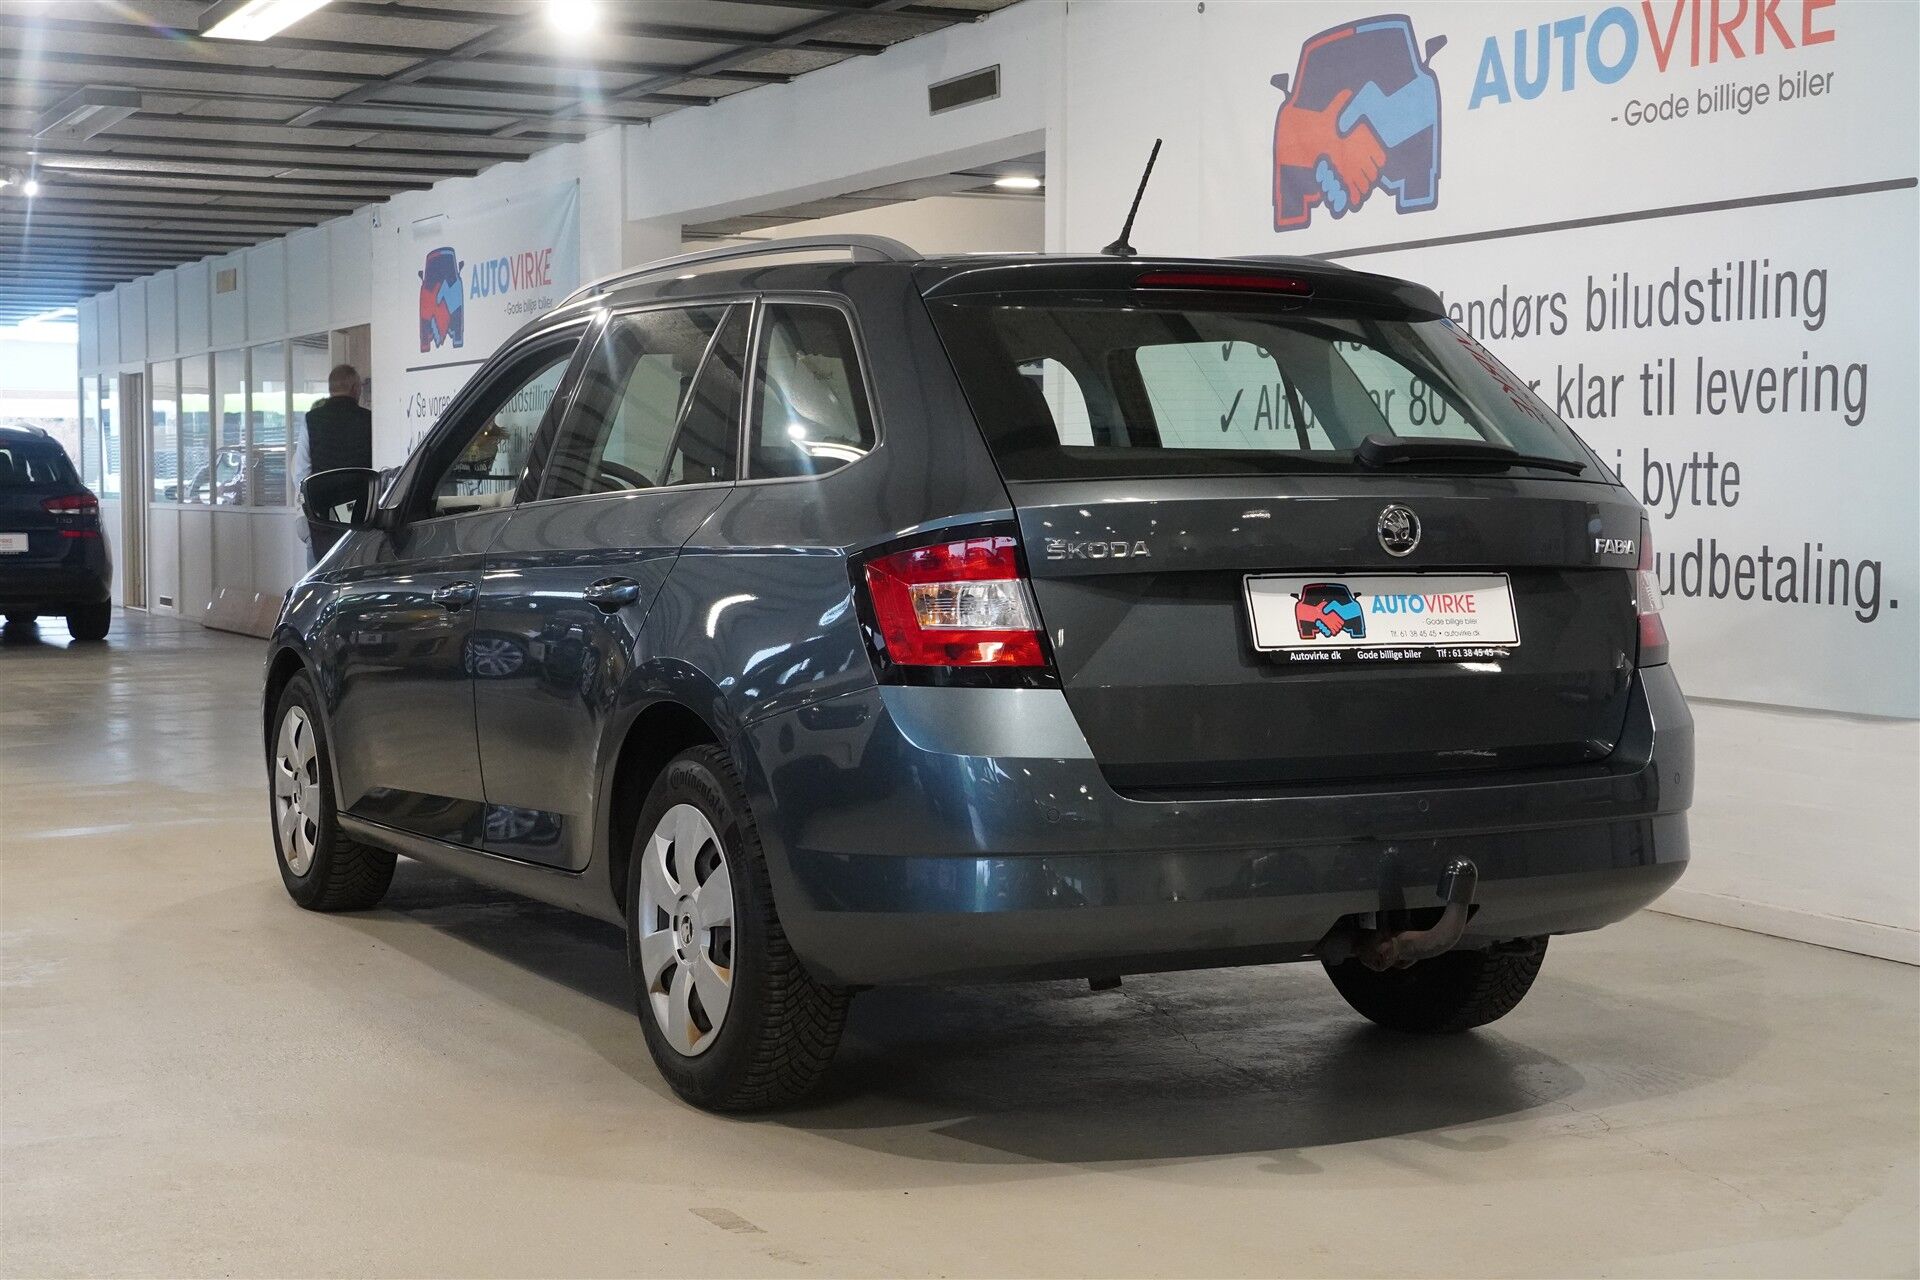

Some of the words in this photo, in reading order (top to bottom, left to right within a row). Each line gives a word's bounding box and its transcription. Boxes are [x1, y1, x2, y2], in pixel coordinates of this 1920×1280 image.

[1624, 96, 1689, 126] Gode
[1698, 83, 1770, 115] billige
[1779, 69, 1834, 102] biler
[470, 249, 553, 299] AUTOVIRKE
[1440, 284, 1568, 341] endørs
[1586, 258, 1828, 332] biludstilling
[416, 392, 426, 418] Se
[1556, 365, 1625, 420] klar
[1639, 358, 1676, 416] til
[1695, 351, 1868, 427] levering
[1642, 447, 1740, 519] bytte
[1048, 539, 1151, 560] ŠKODA
[1595, 538, 1636, 554] FABIA
[1655, 538, 1899, 624] udbetaling.
[1372, 594, 1476, 614] AUTOVIRKE
[1426, 617, 1445, 625] Gode
[1290, 651, 1329, 661] Autovirke
[1357, 651, 1378, 660] Gode
[1380, 650, 1403, 662] billige
[1404, 649, 1422, 659] biler
[1436, 649, 1447, 658] Tlf
[1452, 649, 1462, 657] 61
[1463, 649, 1473, 657] 38
